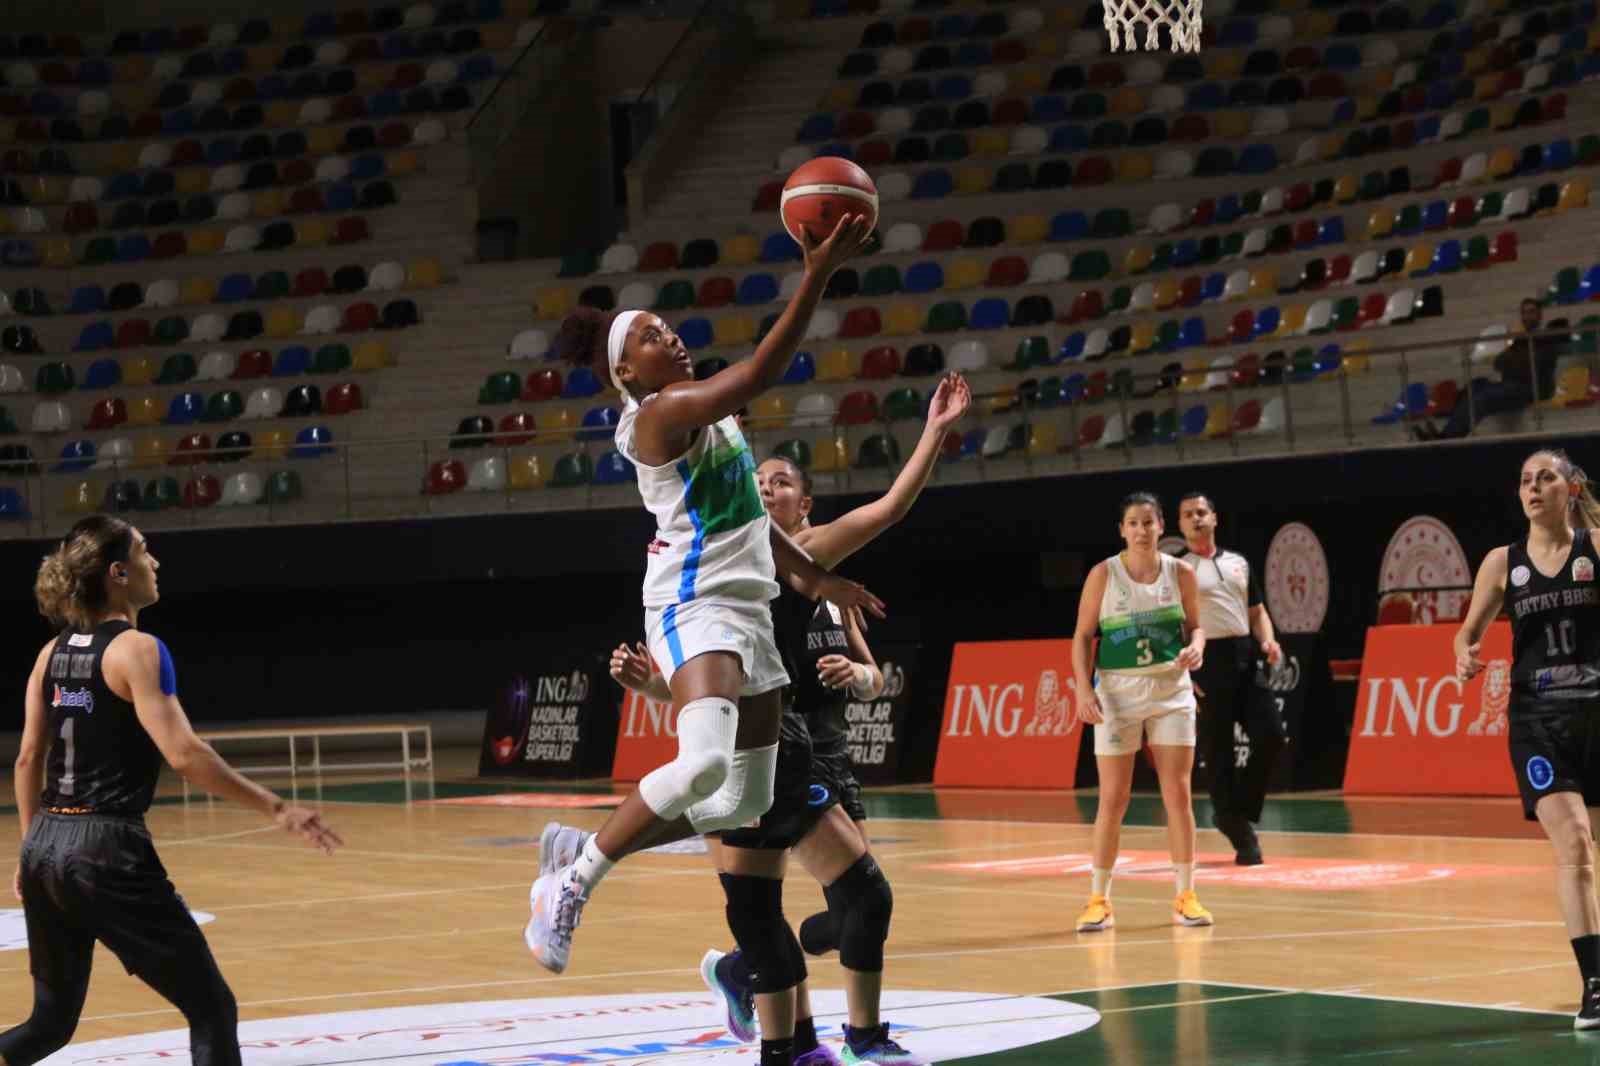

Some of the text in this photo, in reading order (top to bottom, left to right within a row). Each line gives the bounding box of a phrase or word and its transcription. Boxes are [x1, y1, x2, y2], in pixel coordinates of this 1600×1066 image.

[1136, 639, 1153, 666] 3
[1544, 619, 1576, 657] 10
[536, 676, 567, 703] ING
[531, 705, 578, 723] KADINLAR
[945, 682, 1025, 738] ING
[1359, 674, 1465, 738] ING
[528, 724, 580, 742] BASKETBOL
[59, 717, 76, 795] 1
